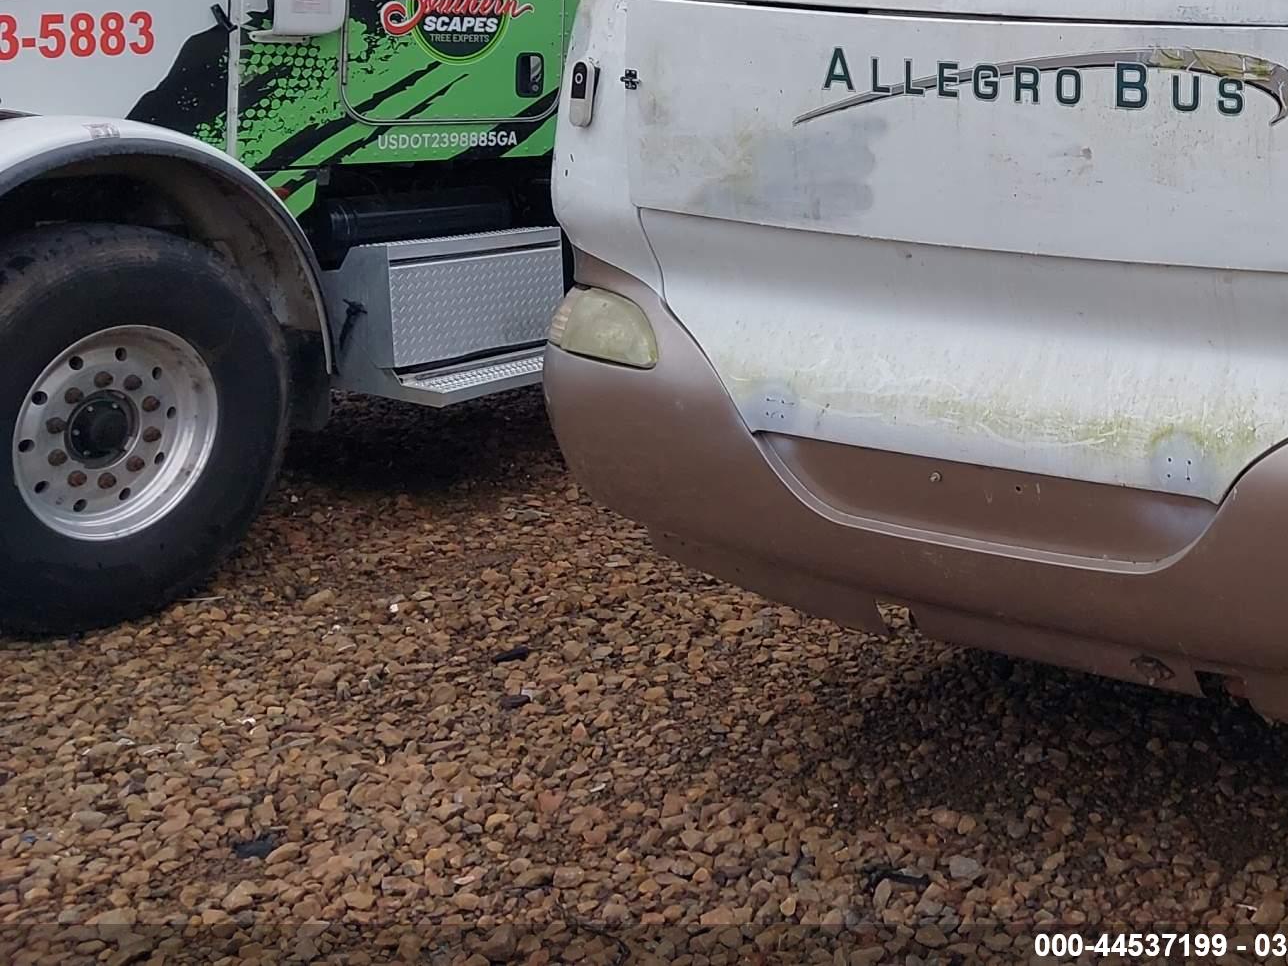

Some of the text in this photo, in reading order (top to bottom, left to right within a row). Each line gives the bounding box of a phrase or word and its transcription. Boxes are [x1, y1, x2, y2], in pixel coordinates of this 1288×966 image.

[423, 16, 499, 33] SCAPES
[430, 34, 490, 43] TREE EXPERTS
[822, 45, 1247, 116] ALLEGRO BUS
[377, 130, 518, 150] USDOT2398885GA
